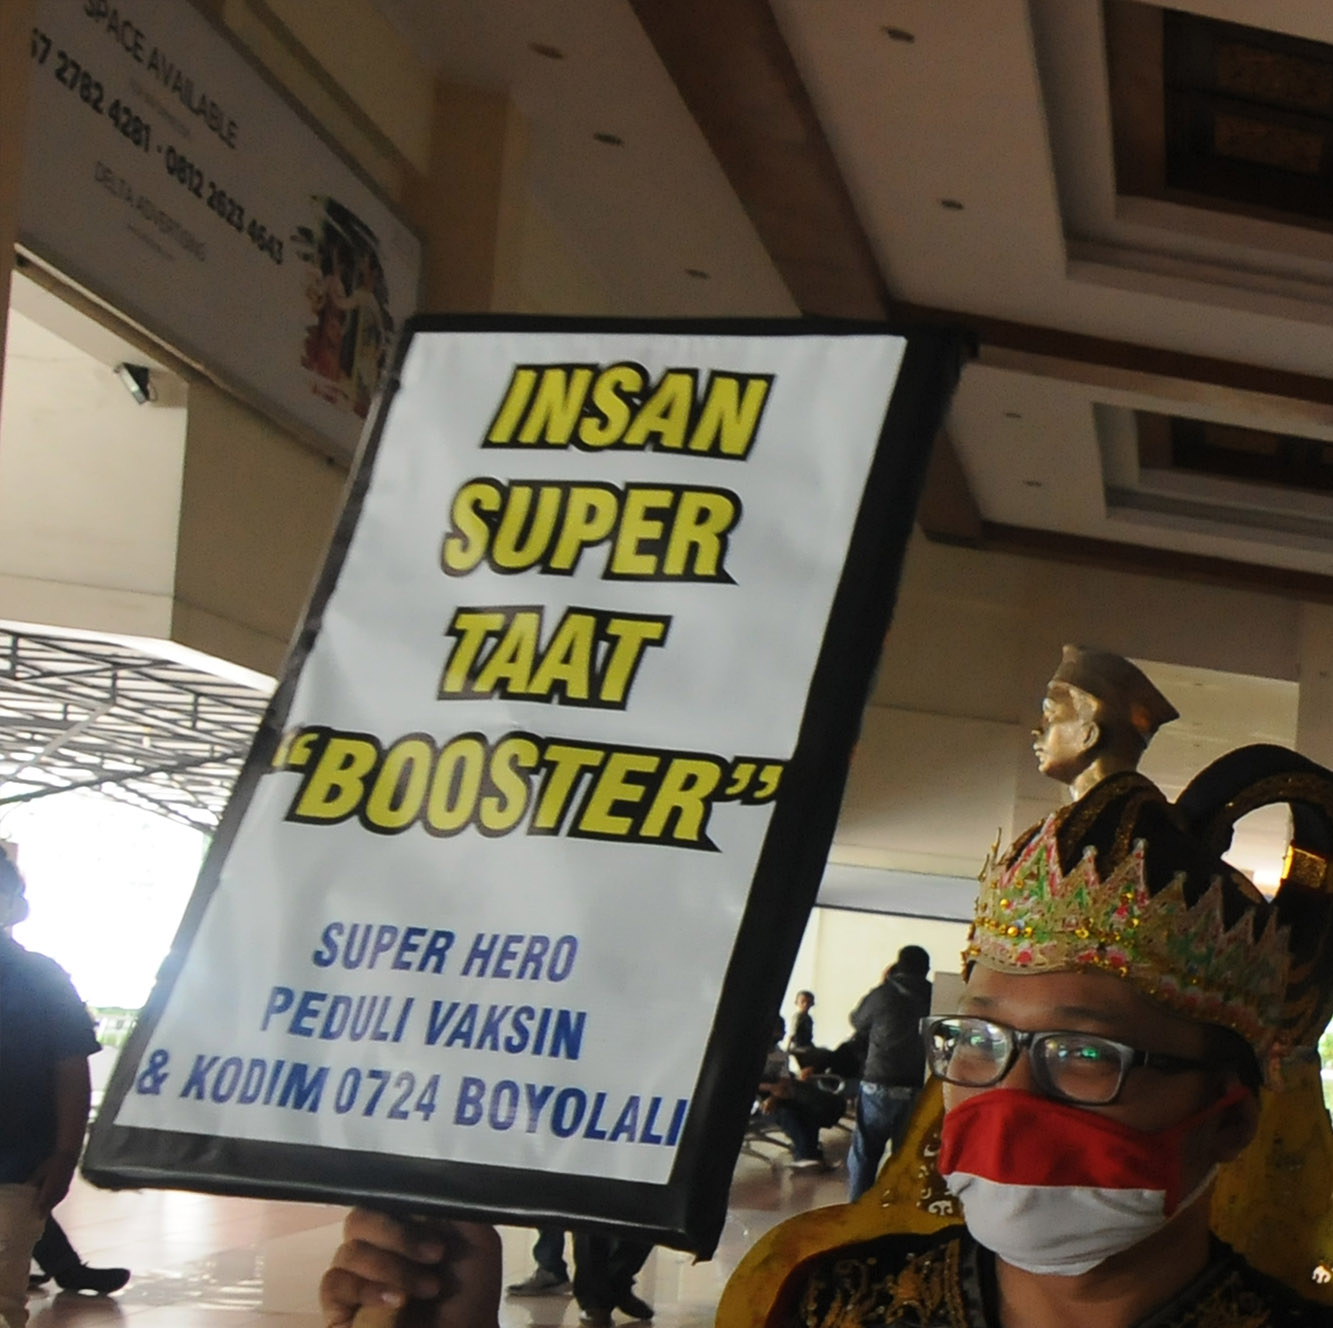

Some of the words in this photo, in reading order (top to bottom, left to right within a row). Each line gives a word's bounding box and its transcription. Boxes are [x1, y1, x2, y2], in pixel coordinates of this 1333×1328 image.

[55, 51, 104, 114] 2782
[108, 98, 150, 153] 4281
[165, 145, 204, 198] 0812
[147, 47, 240, 149] AVAILABLE
[482, 361, 775, 460] INSAN
[441, 477, 742, 584] SUPER
[437, 605, 672, 711] TAAT
[273, 727, 792, 853] “BOOSTER”
[312, 921, 455, 977] SUPER
[463, 928, 579, 984] HERO
[261, 987, 412, 1046] PEDULI
[424, 999, 586, 1061] VAKSIN
[136, 1050, 169, 1094] &
[181, 1054, 329, 1115] KODIM
[334, 1067, 438, 1122] 0724
[455, 1081, 690, 1147] BOYOLALI
